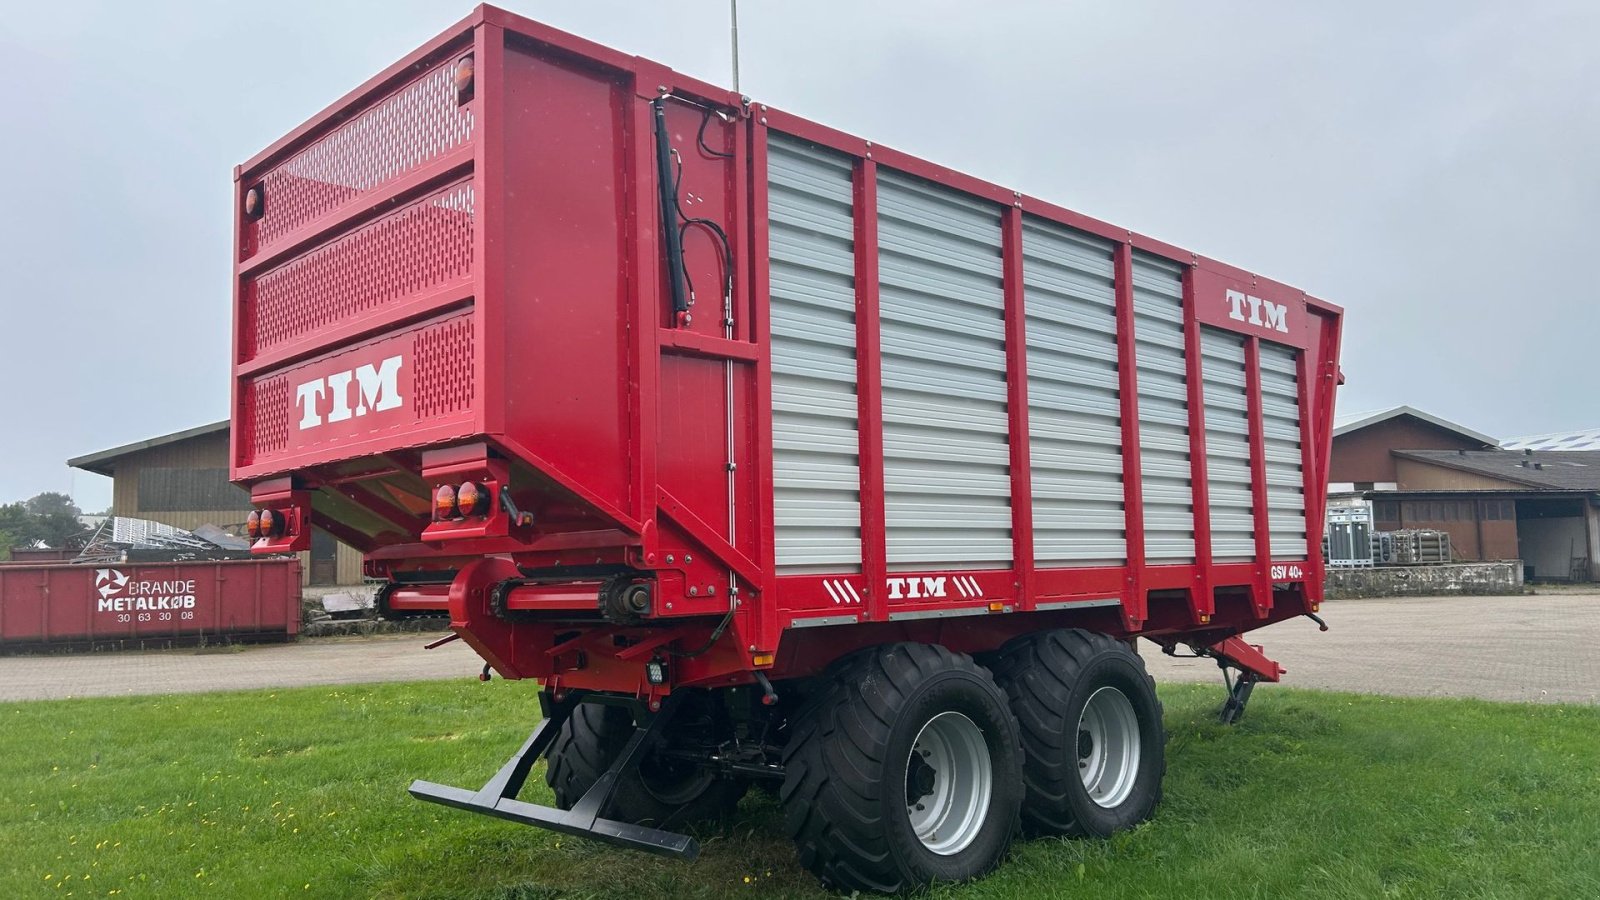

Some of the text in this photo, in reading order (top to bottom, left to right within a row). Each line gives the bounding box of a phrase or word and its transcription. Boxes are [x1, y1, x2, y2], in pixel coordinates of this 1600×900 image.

[1226, 288, 1288, 333] TIM
[296, 355, 402, 430] TIM
[1271, 565, 1303, 579] GSV 40+
[128, 580, 196, 595] BRANDE
[886, 576, 947, 599] TIM
[98, 595, 196, 612] METALKØB
[117, 611, 194, 623] 30 63 30 08
